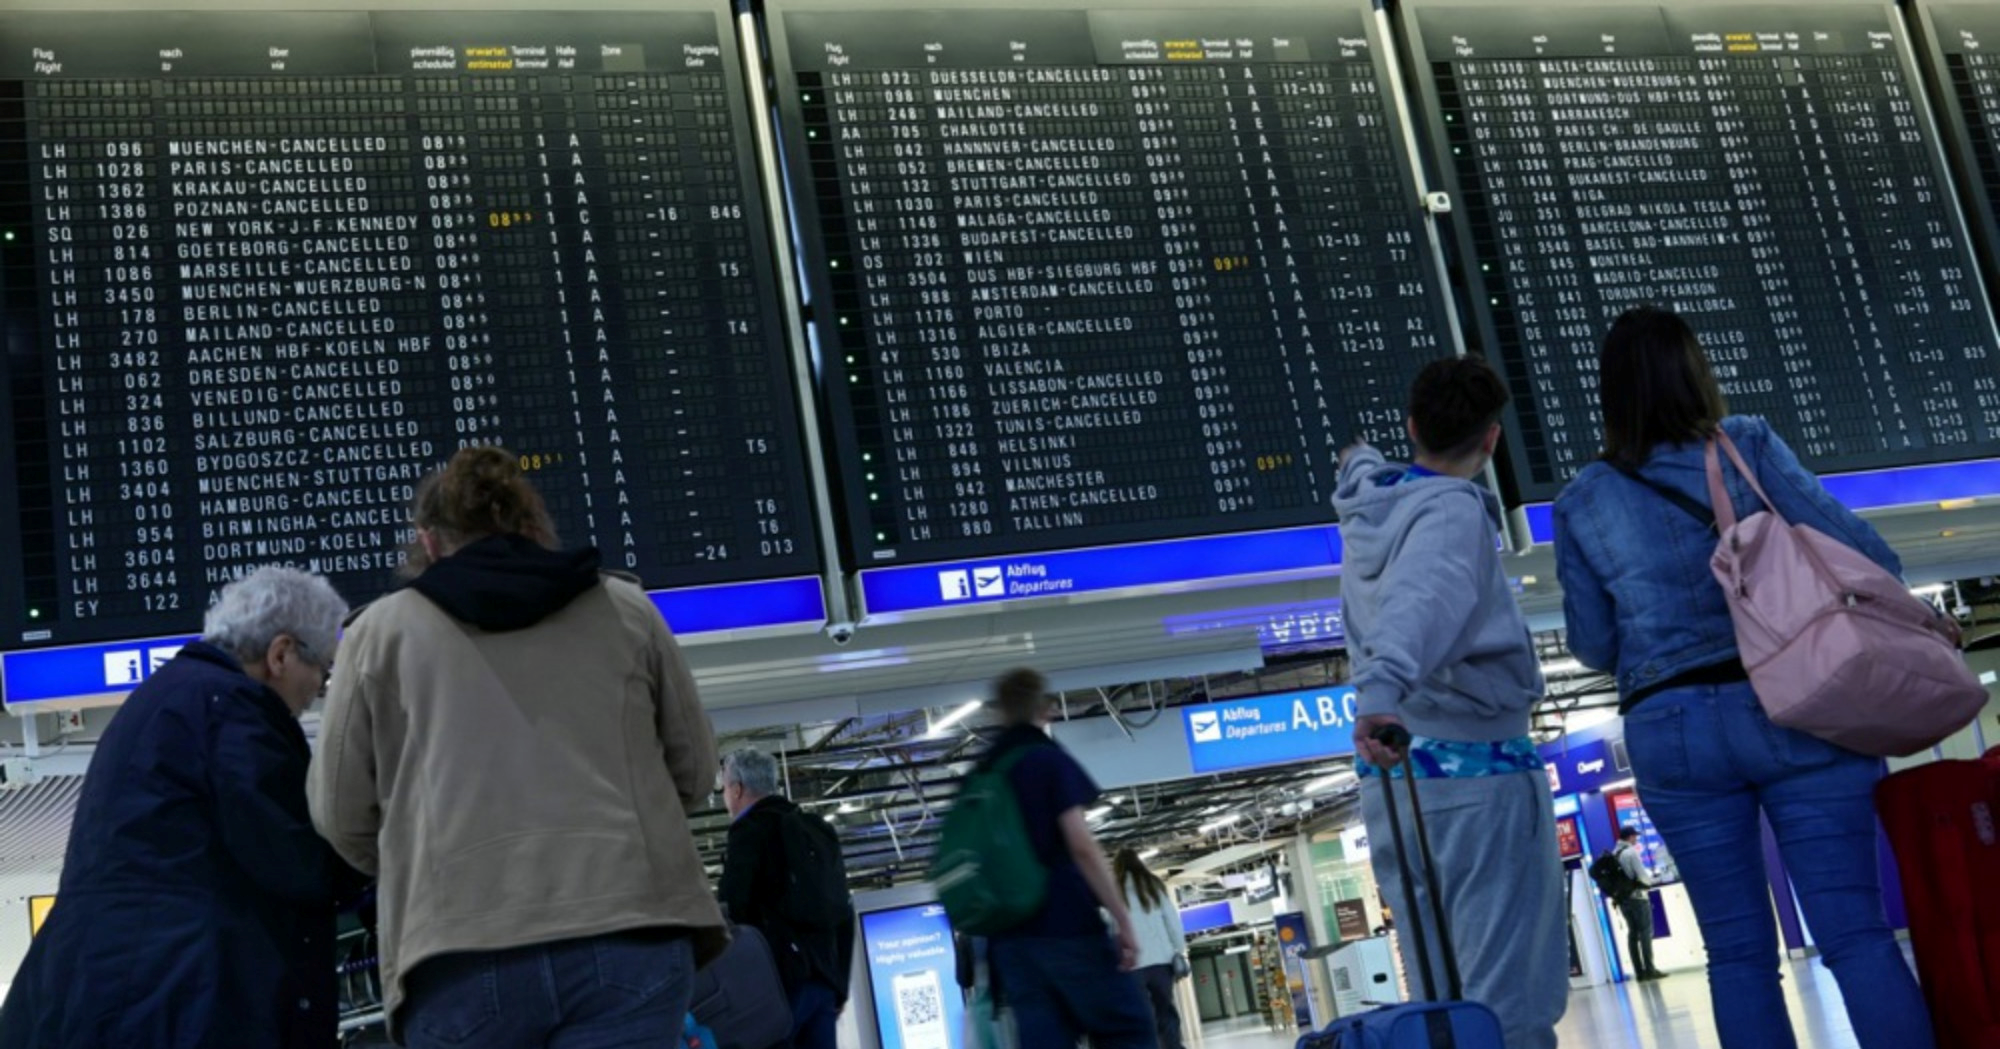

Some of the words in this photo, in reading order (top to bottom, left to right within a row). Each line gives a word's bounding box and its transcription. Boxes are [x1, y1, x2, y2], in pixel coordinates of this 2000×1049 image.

[33, 49, 54, 60] Flug
[160, 49, 182, 58] nach
[269, 48, 289, 58] über
[466, 47, 506, 56] erwartet
[512, 46, 546, 56] Terminal
[556, 46, 576, 56] Halle
[601, 46, 622, 55] Zone
[35, 62, 62, 74] Flight
[162, 63, 172, 71] to
[271, 62, 285, 70] via
[413, 58, 456, 69] scheduled
[468, 58, 512, 69] estimated
[516, 57, 549, 68] Terminal
[558, 58, 574, 68] Hall
[686, 57, 704, 67] Gate
[1538, 60, 1656, 73] MALTA-CANCELLED
[1542, 75, 1697, 89] MUENCHEN-WUERZBURG-N
[933, 89, 1011, 102] MUENCHEN
[1546, 92, 1642, 105] DORTMUND-DUS
[1647, 91, 1702, 103] HBF-ESS
[936, 105, 1099, 120] MAILAND-CANCELLED
[1551, 108, 1631, 121] MARRAKESCH
[940, 124, 1028, 138] CHARLOTTE
[1555, 124, 1596, 137] PARIS
[1602, 124, 1627, 136] CH.
[1633, 123, 1650, 135] DE
[1655, 122, 1703, 134] GAULLE
[40, 144, 66, 158] LH
[106, 143, 142, 157] 096
[169, 138, 386, 156] MUENCHEN-CANCELLED
[1559, 138, 1700, 153] BERLIN-BRANDENBURG
[42, 165, 68, 179] LH
[96, 163, 144, 178] 1028
[170, 159, 353, 176] PARIS-CANCELLED
[946, 157, 1100, 174] BREMEN-CANCELLED
[1563, 154, 1674, 169] PRAG-CANCELLED
[950, 174, 1131, 192] STUTTGART-CANCELLED
[1567, 169, 1708, 185] BUKAREST-CANCELLED
[43, 185, 69, 200] LH
[97, 184, 146, 199] 1362
[172, 178, 367, 197] KRAKAU-CANCELLED
[1572, 189, 1605, 202] RIGA
[45, 206, 71, 221] LH
[99, 204, 148, 219] 1386
[174, 198, 369, 217] POZNAN-CANCELLED
[953, 193, 1098, 210] PARIS-CANCELLED
[1576, 204, 1633, 218] BELGRAD
[1639, 202, 1687, 215] NIKOLA
[1692, 200, 1732, 213] TESLA
[956, 210, 1111, 228] MALAGA-CANCELLED
[1580, 216, 1729, 234] BARCELONA-CANCELLED
[46, 227, 73, 242] SQ
[113, 225, 149, 240] 026
[176, 223, 212, 238] NEW
[226, 217, 419, 236] YORK-J.F.KENNEDY
[960, 227, 1133, 247] BUDAPEST-CANCELLED
[48, 248, 74, 263] LH
[114, 246, 151, 261] 814
[177, 237, 409, 259] GOETEBORG-CANCELLED
[1584, 237, 1626, 251] BASEL
[1632, 232, 1741, 249] BAD-MANNHEIM-K
[963, 251, 1004, 265] WIEN
[1589, 253, 1654, 268] MONTREAL
[49, 270, 76, 285] LH
[104, 267, 153, 282] 1086
[179, 257, 411, 280] MARSEILLE-CANCELLED
[967, 269, 998, 284] DUS
[1006, 264, 1122, 282] HBF-SIEGBURG
[1129, 262, 1159, 276] HBF
[1593, 266, 1720, 284] MADRID-CANCELLED
[51, 291, 77, 306] LH
[105, 288, 155, 304] 3450
[181, 277, 425, 301] MUENCHEN-WUERZBURG-N
[970, 280, 1153, 302] AMSTERDAM-CANCELLED
[1597, 282, 1717, 301] TORONTO-PEARSON
[52, 312, 79, 327] LH
[120, 309, 156, 324] 178
[183, 299, 380, 322] BERLIN-CANCELLED
[913, 309, 954, 324] 1176
[974, 305, 1024, 321] PORTO
[54, 334, 81, 349] LH
[121, 330, 158, 346] 270
[185, 319, 394, 343] MAILAND-CANCELLED
[917, 328, 958, 343] 1316
[977, 318, 1133, 340] ALGIER-CANCELLED
[56, 355, 82, 371] LH
[110, 351, 160, 368] 3482
[187, 346, 261, 364] AACHEN
[275, 340, 384, 360] HBF-KOELN
[397, 338, 432, 353] HBF
[930, 347, 961, 361] 530
[983, 342, 1031, 358] IBIZA
[124, 373, 162, 389] 062
[188, 360, 399, 385] DRESDEN-CANCELLED
[923, 366, 965, 381] 1160
[984, 359, 1064, 377] VALENCIA
[927, 385, 968, 400] 1166
[987, 372, 1163, 396] LISSABON-CANCELLED
[126, 394, 164, 411] 324
[190, 381, 401, 407] VENEDIG-CANCELLED
[930, 404, 972, 420] 1186
[991, 391, 1157, 415] ZUERICH-CANCELLED
[128, 416, 165, 432] 836
[192, 402, 403, 429] BILLUND-CANCELLED
[934, 423, 975, 439] 1322
[995, 411, 1142, 434] TUNIS-CANCELLED
[117, 438, 167, 455] 1102
[194, 422, 418, 450] SALZBURG-CANCELLED
[947, 442, 979, 458] 848
[998, 435, 1076, 454] HELSINKI
[119, 459, 169, 477] 1360
[196, 442, 432, 472] BYDGOSZCZ-CANCELLED
[950, 461, 982, 477] 894
[1002, 454, 1073, 473] VILNIUS
[120, 481, 171, 499] 3404
[954, 481, 986, 497] 942
[1005, 471, 1105, 492] MANCHESTER
[135, 503, 173, 521] 010
[200, 486, 413, 516] HAMBURG-CANCELLED
[948, 500, 989, 517] 1280
[1009, 486, 1157, 512] ATHEN-CANCELLED
[137, 526, 175, 543] 954
[202, 508, 416, 538] BIRMINGHA-CANCELL
[961, 520, 993, 536] 880
[1012, 512, 1084, 531] TALLINN
[125, 548, 176, 566] 3604
[393, 529, 418, 545] HB
[127, 570, 178, 589] 3644
[1007, 564, 1046, 578] Abflug
[1010, 578, 1073, 594] Departures
[73, 599, 100, 617] EY
[143, 593, 180, 611] 122
[1222, 706, 1260, 722] Abflug
[1226, 721, 1287, 738] Departures
[1578, 759, 1604, 774] Change
[878, 940, 900, 950] Your
[902, 932, 942, 946] opinion?
[876, 952, 905, 965] Highly
